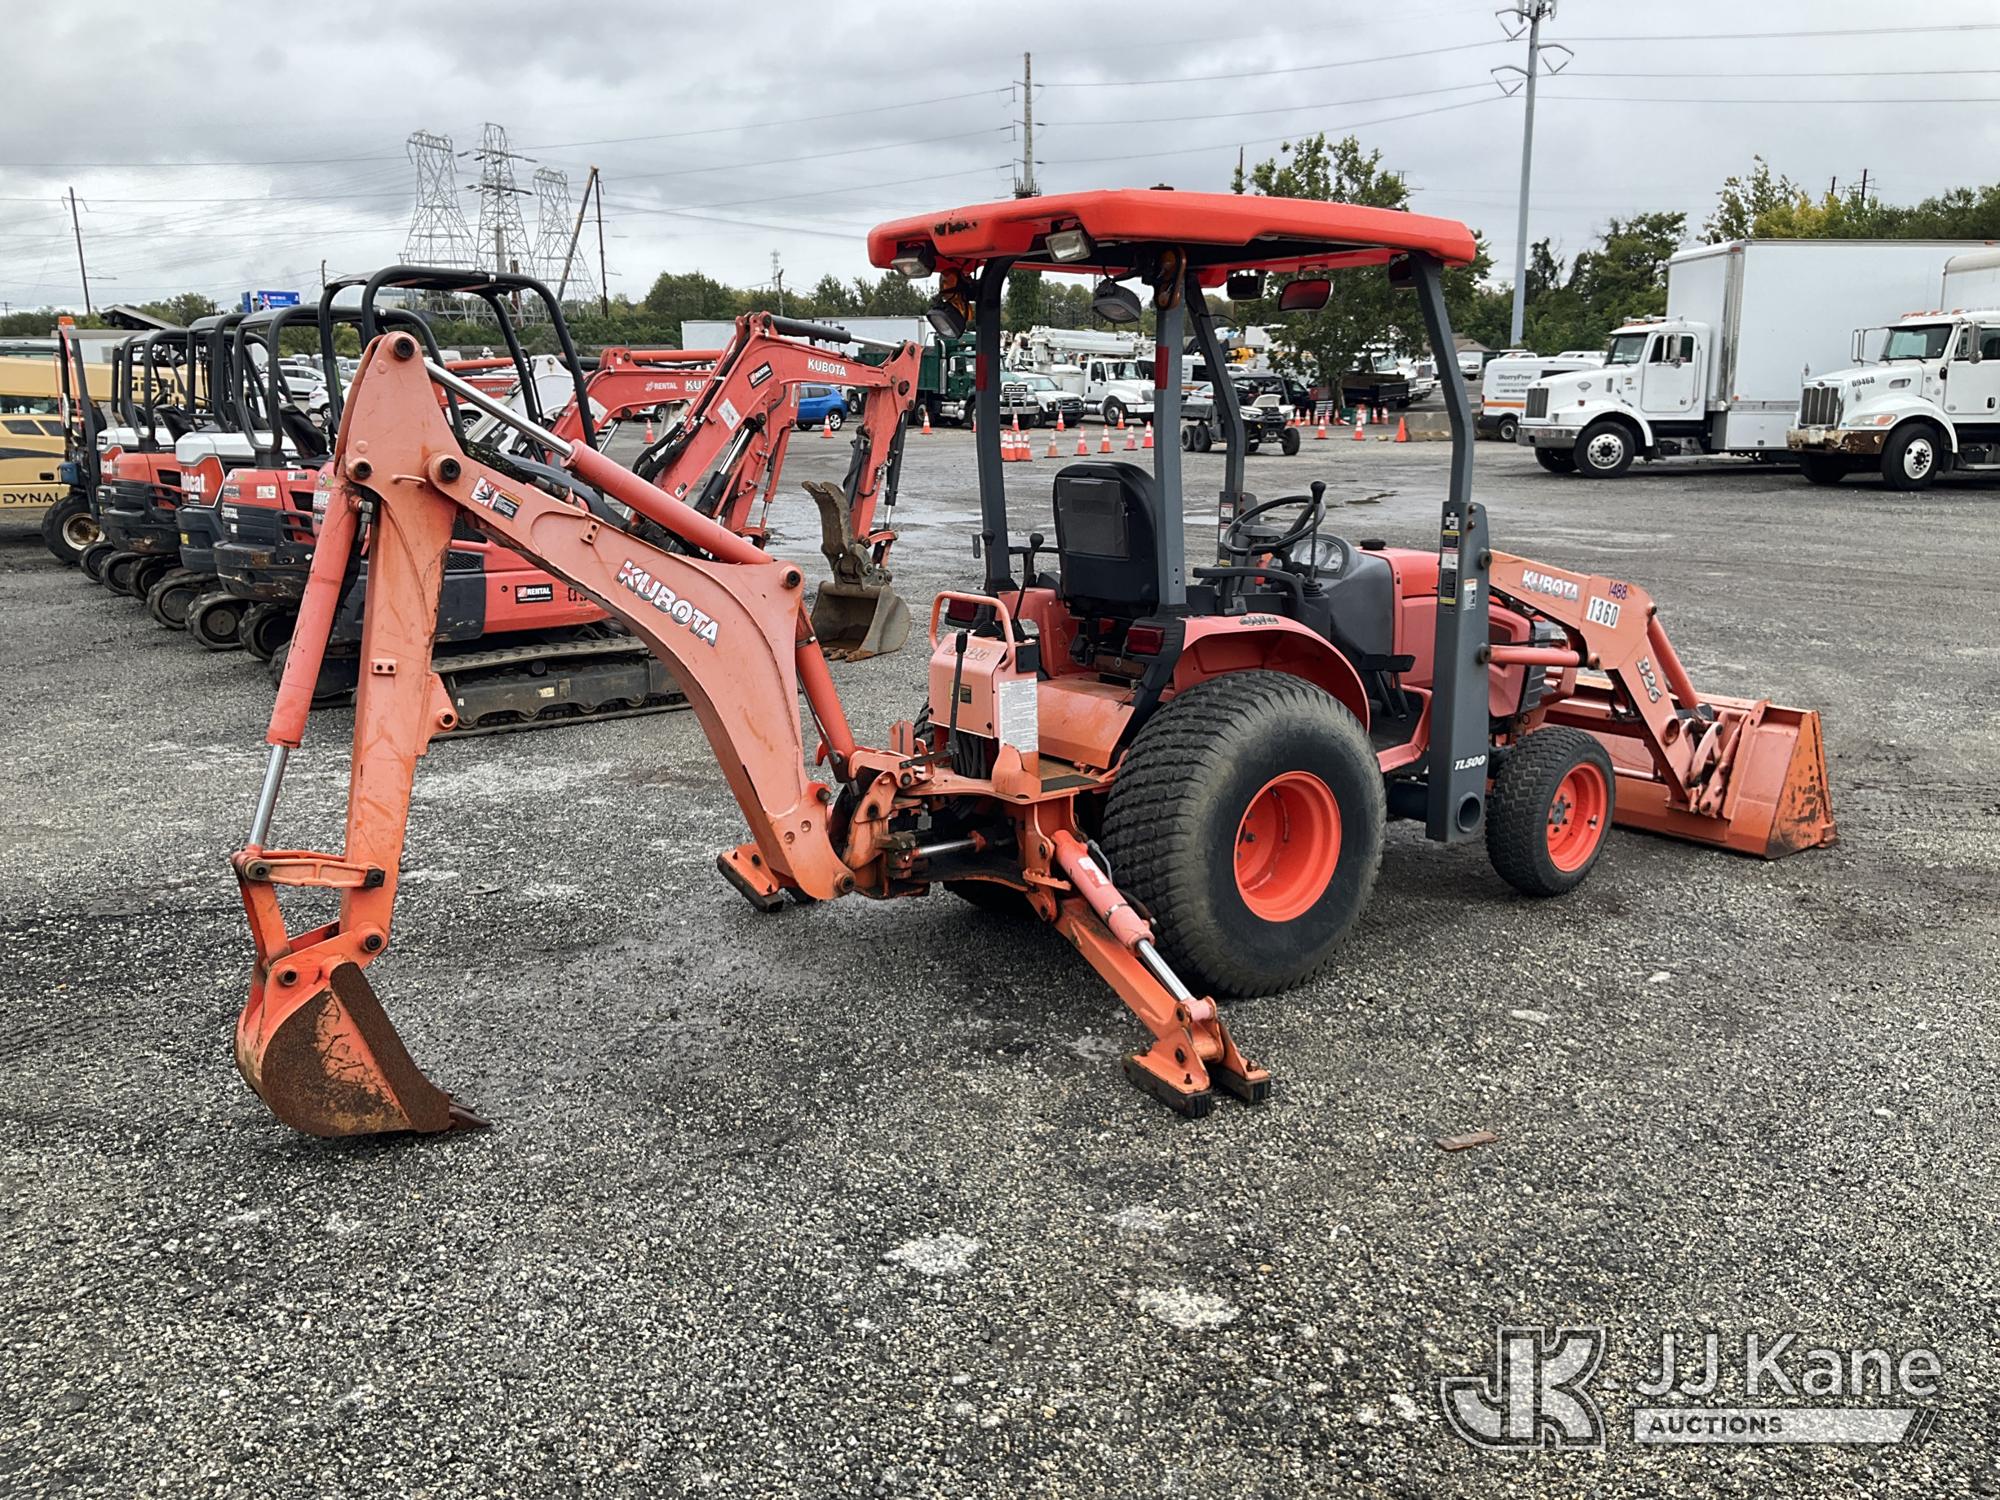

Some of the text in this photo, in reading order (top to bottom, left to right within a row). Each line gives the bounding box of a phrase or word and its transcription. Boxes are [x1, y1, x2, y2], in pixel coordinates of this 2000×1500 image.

[807, 358, 847, 377] KUBOTA
[654, 382, 678, 390] RENTAL
[527, 587, 551, 596] RENTAL
[1522, 569, 1579, 600] KUBOTA
[1608, 581, 1628, 600] 1488
[616, 559, 719, 647] KUBOTA
[1589, 598, 1618, 627] 1360
[1636, 655, 1662, 704] B26
[1454, 754, 1486, 771] TL500
